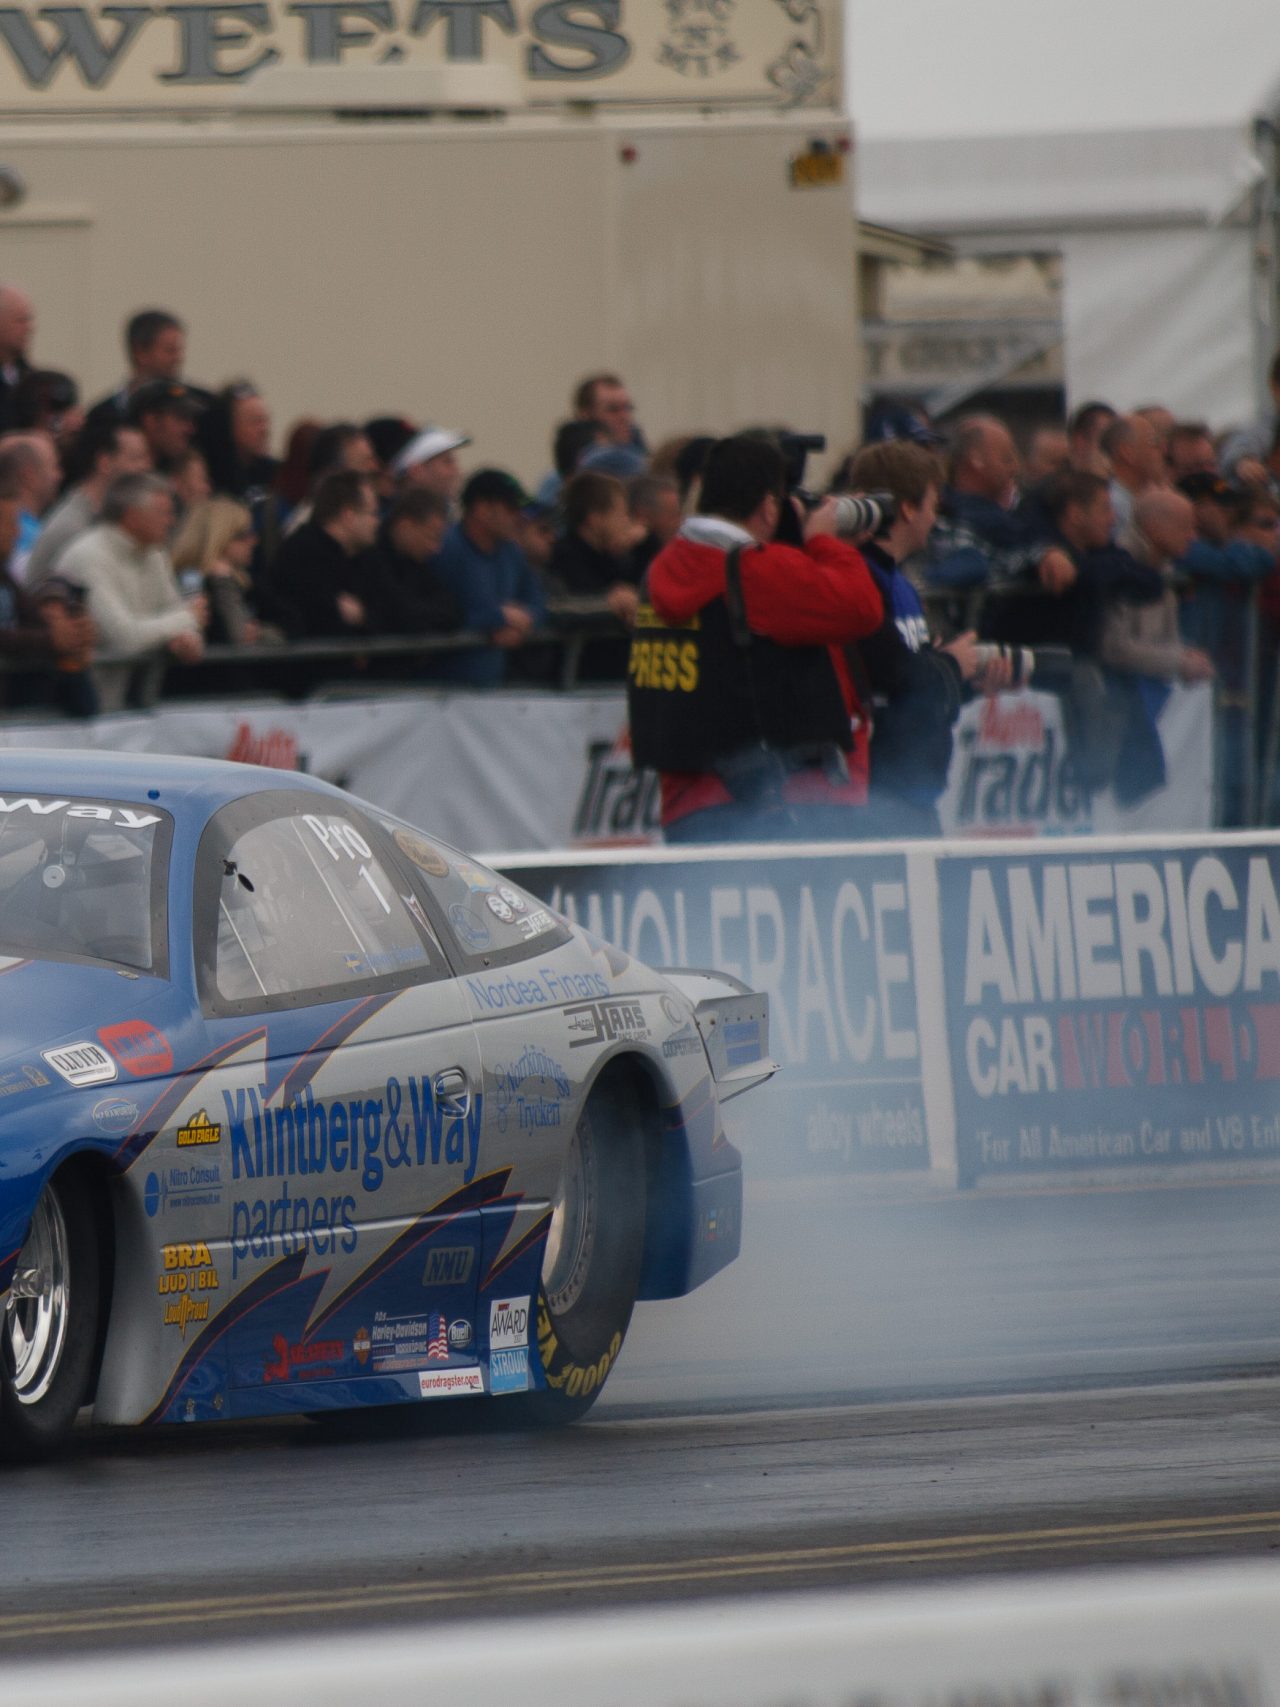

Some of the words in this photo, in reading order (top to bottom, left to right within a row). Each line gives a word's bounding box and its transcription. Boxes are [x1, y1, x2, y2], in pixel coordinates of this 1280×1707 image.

[302, 814, 371, 860] Pro
[359, 865, 391, 914] 1
[467, 977, 546, 1009] Nordea
[541, 969, 610, 999] Finans
[566, 882, 918, 1064] FRACE
[593, 1001, 646, 1042] HAAS
[51, 1046, 108, 1074] CLUTCH
[967, 1015, 1057, 1098] CAR
[1140, 1118, 1171, 1154] Car
[170, 1168, 188, 1187] Nitro
[190, 1165, 220, 1185] Consult
[231, 1182, 358, 1280] partners
[164, 1241, 212, 1270] BRA
[159, 1274, 187, 1294] LJUD
[198, 1270, 219, 1289] BIL
[491, 1308, 527, 1338] AWARD
[491, 1350, 528, 1377] STROUD
[421, 1373, 480, 1391] eurodragster.com
